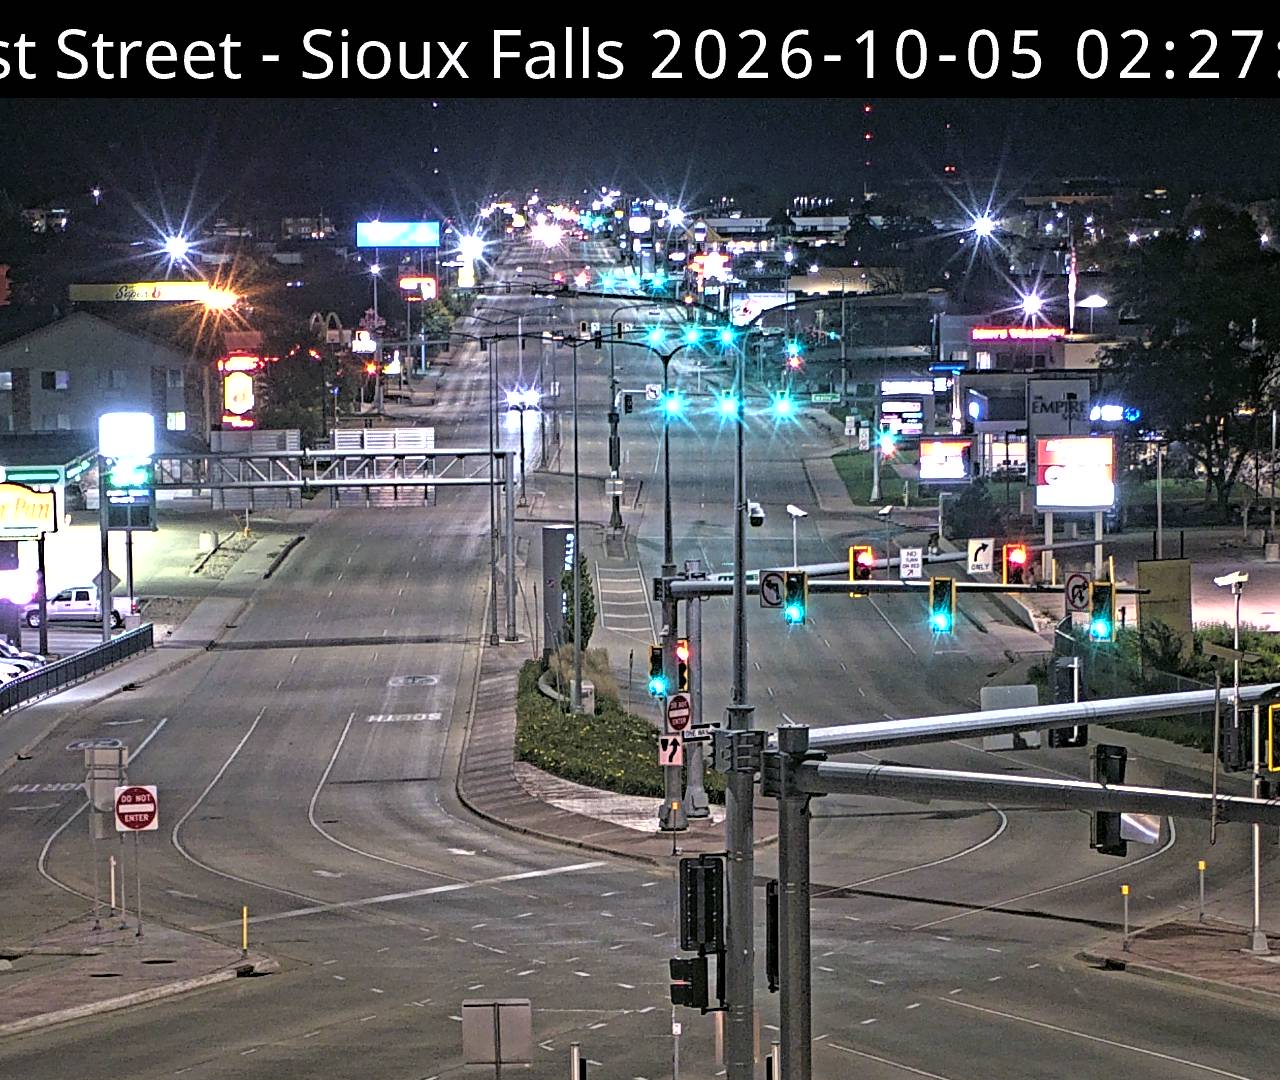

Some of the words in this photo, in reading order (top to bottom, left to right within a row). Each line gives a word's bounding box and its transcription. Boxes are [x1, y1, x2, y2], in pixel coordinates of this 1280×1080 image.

[906, 550, 917, 558] NO
[971, 563, 990, 571] ONLY
[121, 795, 133, 803] DO
[135, 794, 151, 802] NOT
[124, 814, 149, 822] ENTER
